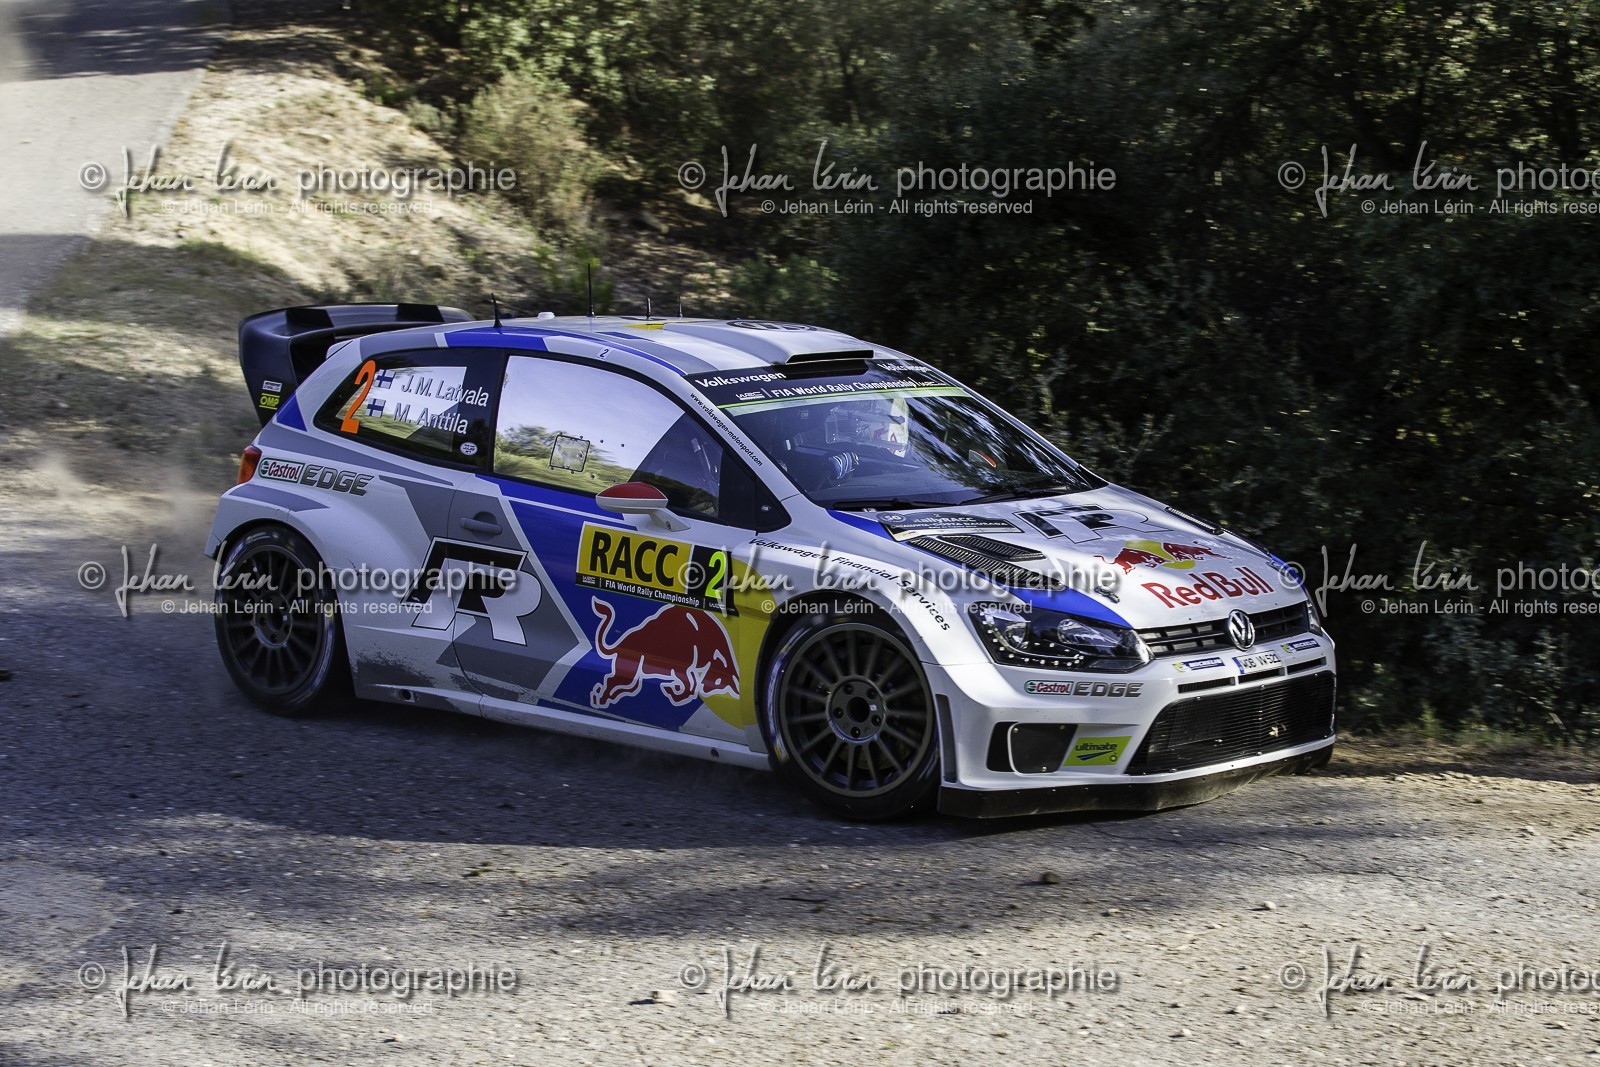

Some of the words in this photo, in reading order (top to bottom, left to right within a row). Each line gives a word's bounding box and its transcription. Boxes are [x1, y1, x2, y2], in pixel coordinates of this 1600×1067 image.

[600, 348, 609, 358] 2
[695, 372, 786, 388] Volkswagen
[770, 388, 795, 398] FIA
[792, 384, 828, 395] World
[826, 382, 855, 392] Rally
[853, 380, 916, 390] Championship
[340, 360, 376, 434] 2
[392, 402, 412, 424] M.
[418, 407, 469, 435] Anttila
[690, 392, 763, 467] www.volkswagen-motorsport.com
[268, 462, 301, 480] Castrol
[300, 464, 375, 496] EDGE
[590, 531, 679, 586] RACC
[704, 550, 726, 600] 2
[748, 538, 830, 560] Volkswagen
[831, 556, 898, 582] Financial
[896, 580, 951, 631] Services
[605, 580, 616, 589] FIA
[617, 582, 636, 593] World
[637, 586, 653, 598] Rally
[654, 590, 700, 607] Championship
[1036, 682, 1070, 693] Castrol
[1072, 682, 1144, 698] EDGE
[1075, 742, 1118, 752] ultimate
